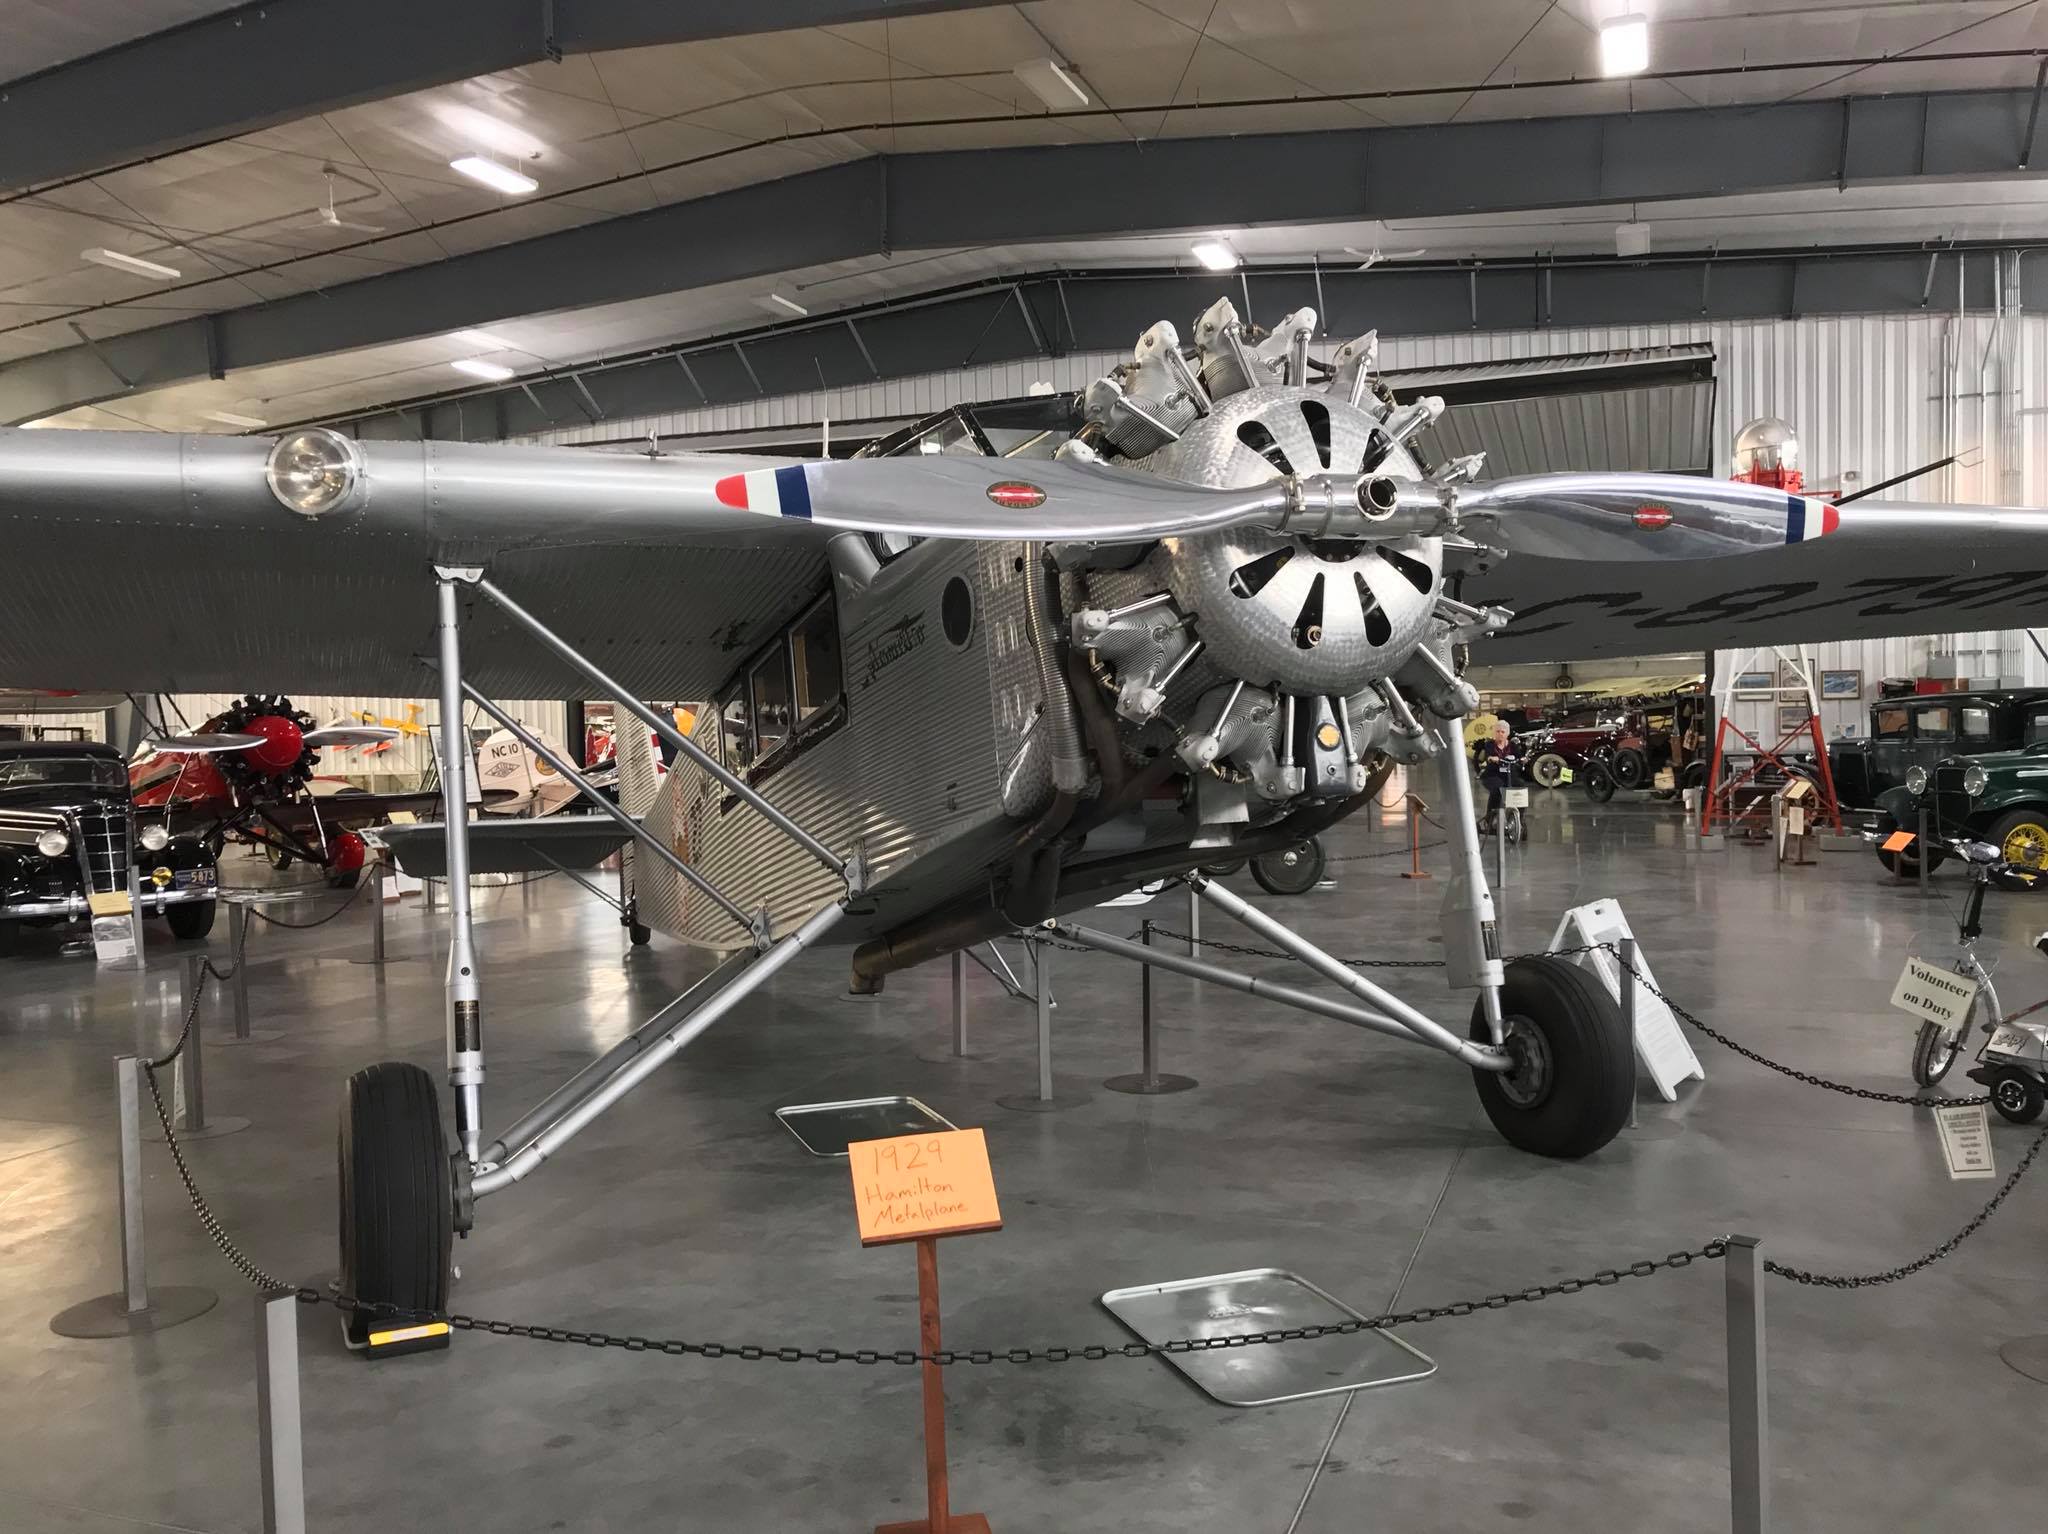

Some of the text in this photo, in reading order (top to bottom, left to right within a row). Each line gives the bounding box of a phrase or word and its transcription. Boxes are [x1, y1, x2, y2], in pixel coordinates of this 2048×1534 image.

[491, 745, 507, 758] NC
[1910, 964, 1971, 998] Volunteer
[1903, 992, 1952, 1020] on Duty
[874, 1139, 943, 1175] 1929
[865, 1177, 954, 1205] Hamilton
[874, 1202, 968, 1228] Metalplane
